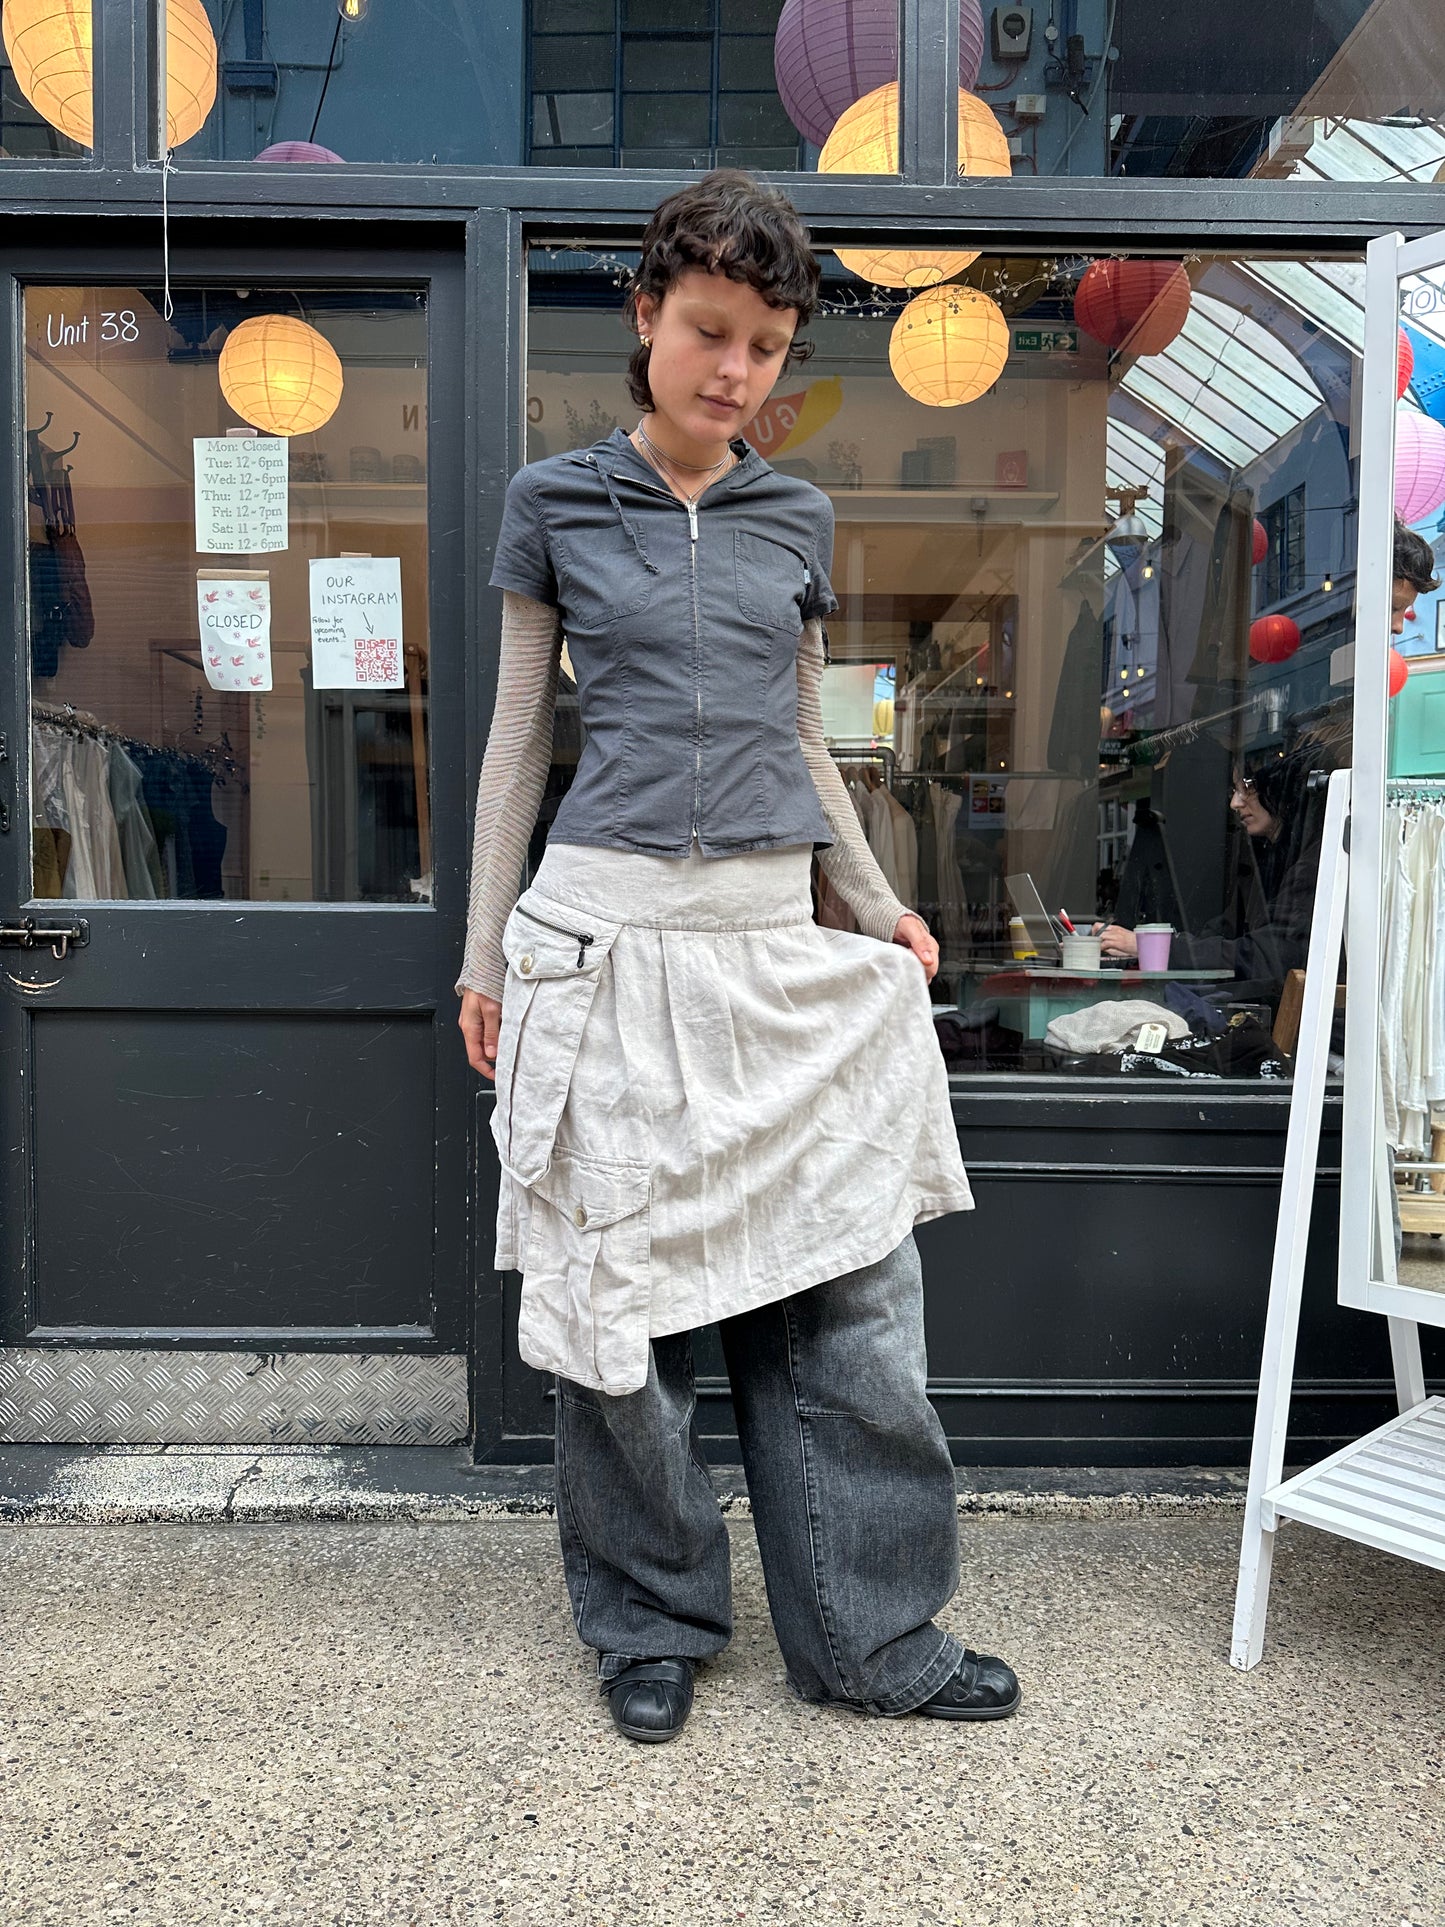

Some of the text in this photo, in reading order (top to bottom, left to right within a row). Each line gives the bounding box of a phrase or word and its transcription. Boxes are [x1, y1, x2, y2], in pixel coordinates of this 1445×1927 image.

[47, 310, 139, 347] Unit 38
[208, 440, 281, 451] Mon: Closed
[206, 457, 232, 468] Tue:
[204, 473, 236, 484] Wed:
[201, 490, 231, 500] Thu:
[212, 506, 232, 517] Fri:
[212, 523, 233, 533] Sat:
[208, 539, 234, 550] Sun:
[326, 576, 355, 587] OUR
[322, 592, 398, 605] INSTAGRAM
[206, 614, 262, 629] CLOSED
[333, 616, 343, 628] for
[314, 628, 346, 638] upcoming
